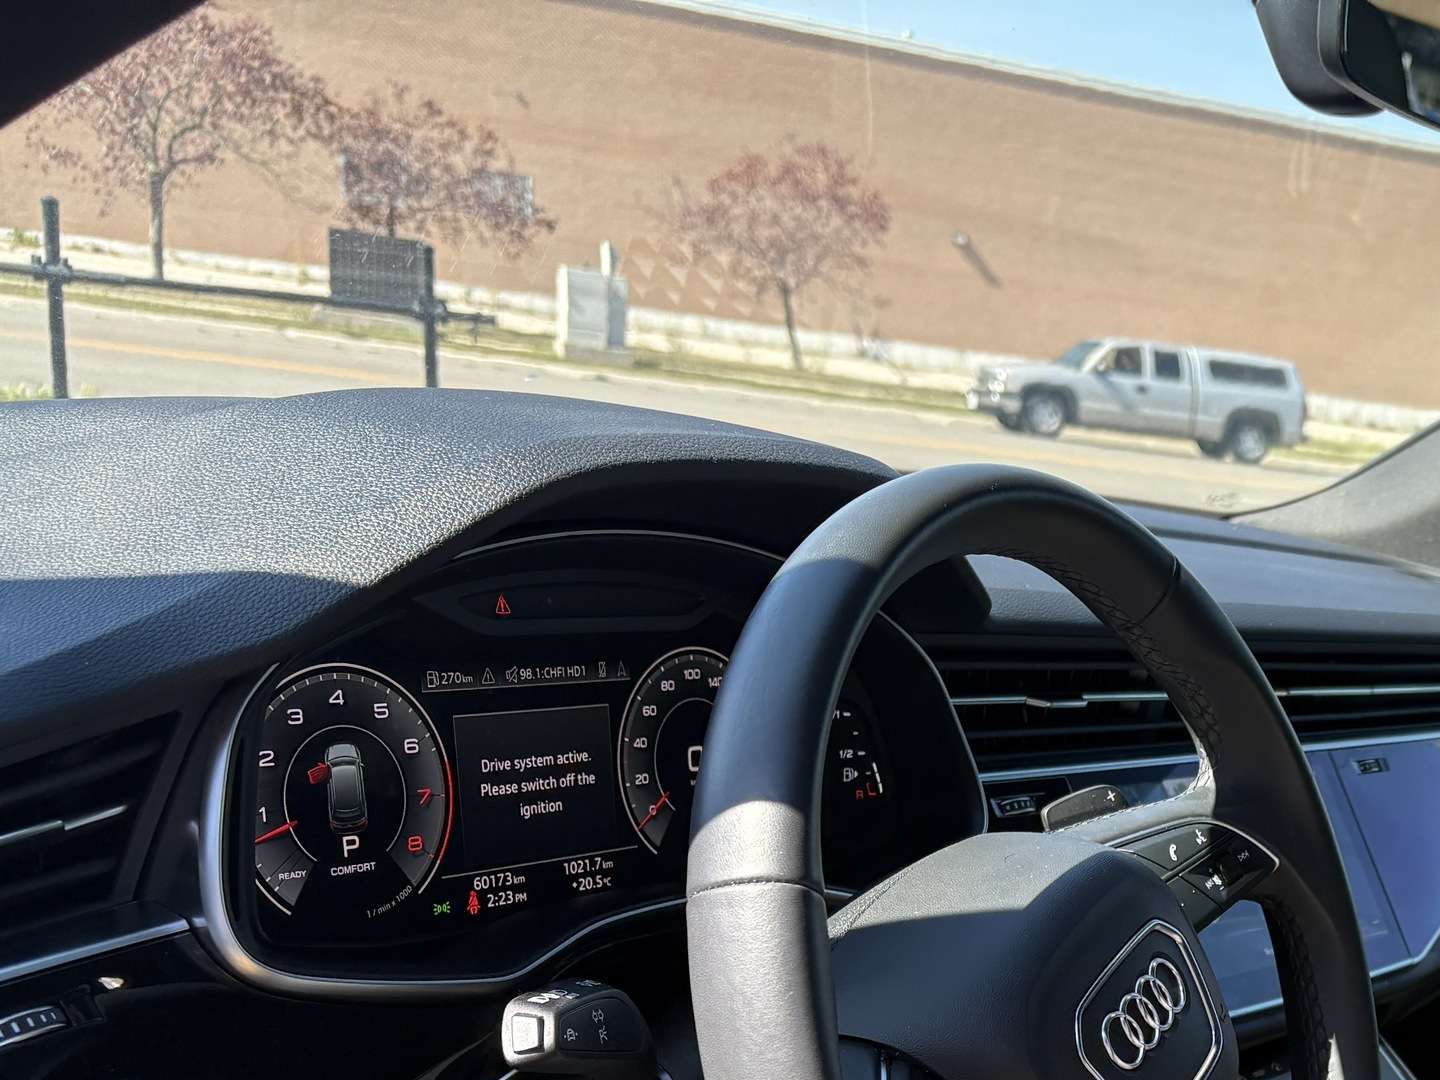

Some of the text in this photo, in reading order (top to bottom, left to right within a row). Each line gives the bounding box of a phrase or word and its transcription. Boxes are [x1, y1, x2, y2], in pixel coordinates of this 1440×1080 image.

[684, 669, 700, 680] 100
[661, 680, 675, 692] 80
[329, 690, 345, 706] 4
[287, 708, 304, 725] 3
[373, 702, 389, 719] 5
[642, 705, 657, 717] 60
[404, 738, 419, 754] 6
[633, 737, 648, 749] 40
[258, 750, 275, 767] 2
[481, 750, 592, 773] Drive system active.
[839, 749, 854, 759] 1/2
[480, 773, 596, 797] Please switch off the
[635, 773, 649, 785] 20
[416, 788, 432, 806] 7
[258, 807, 267, 823] 1
[519, 800, 563, 819] ignition
[342, 836, 360, 858] P
[408, 836, 423, 851] 8
[278, 870, 307, 881] READY
[330, 862, 376, 876] COMFORT
[396, 885, 413, 902] 1000
[487, 891, 527, 908] 2:23 PM
